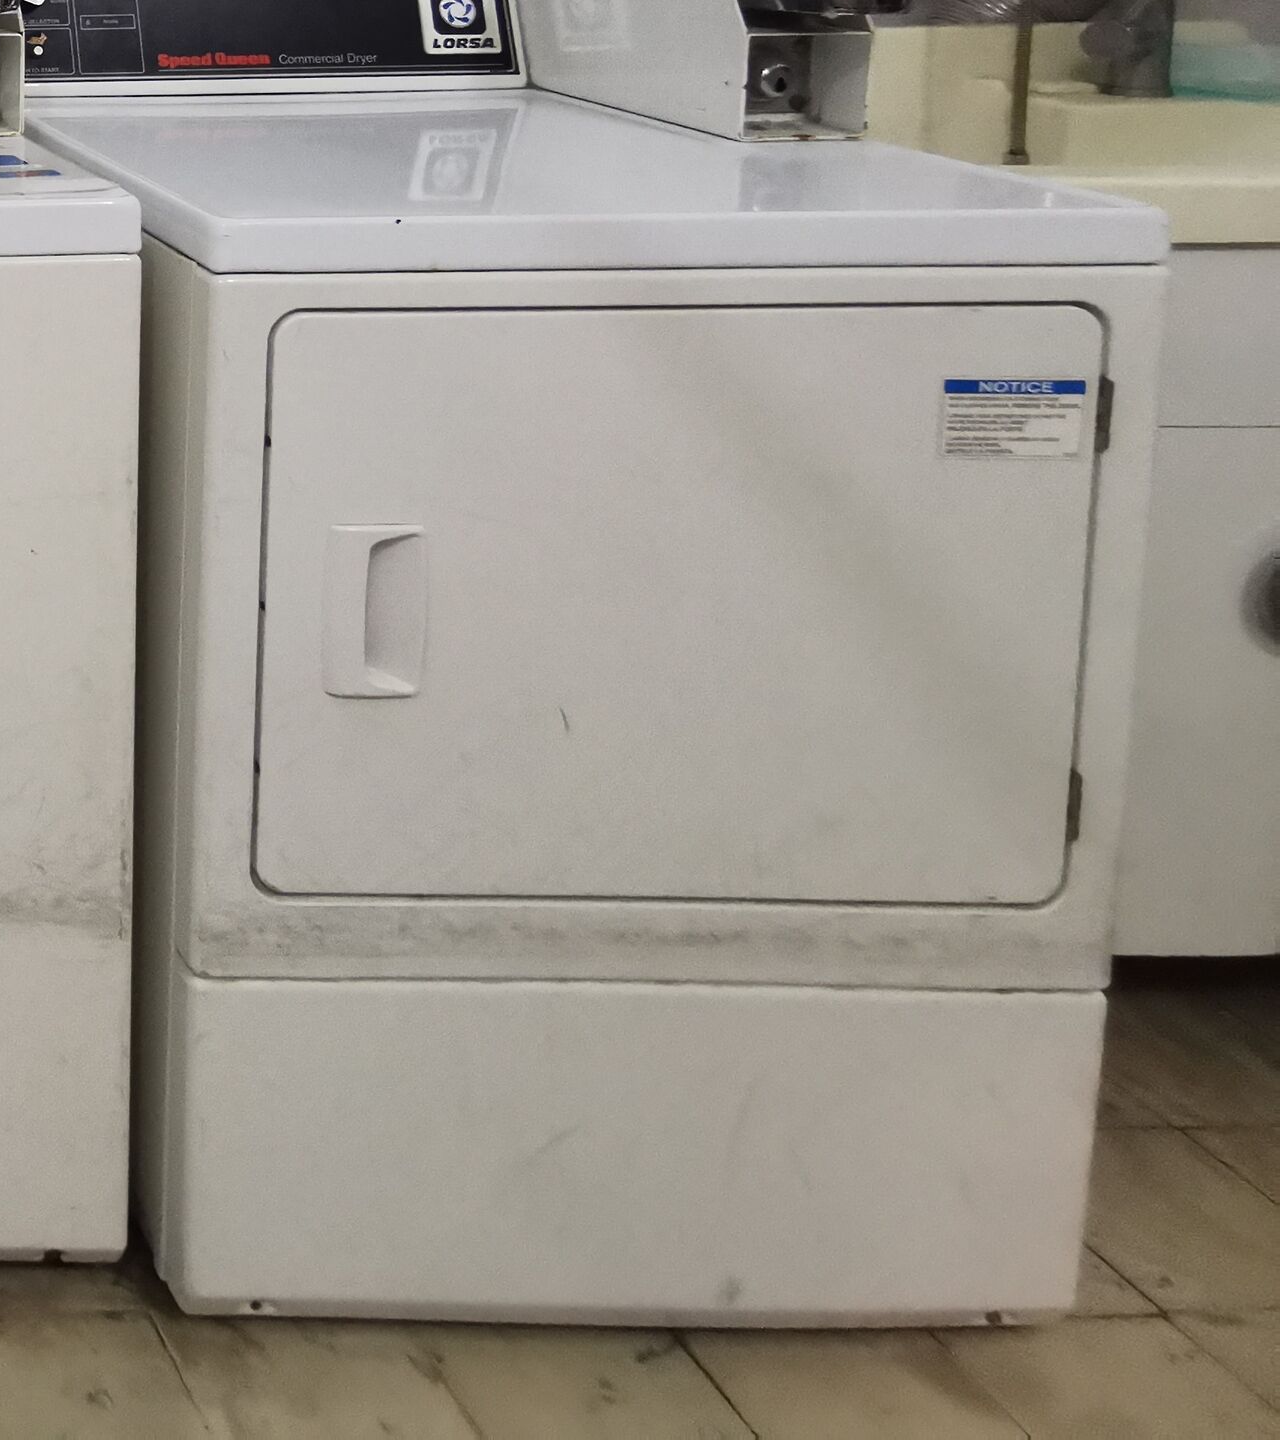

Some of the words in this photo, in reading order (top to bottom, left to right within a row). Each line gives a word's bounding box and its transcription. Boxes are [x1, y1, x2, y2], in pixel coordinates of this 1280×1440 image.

[432, 38, 495, 49] LORSA
[158, 52, 213, 68] Speed
[215, 51, 271, 66] Queen
[279, 54, 344, 65] Commercial
[347, 53, 378, 66] Dryer
[978, 381, 1055, 393] NOTICE
